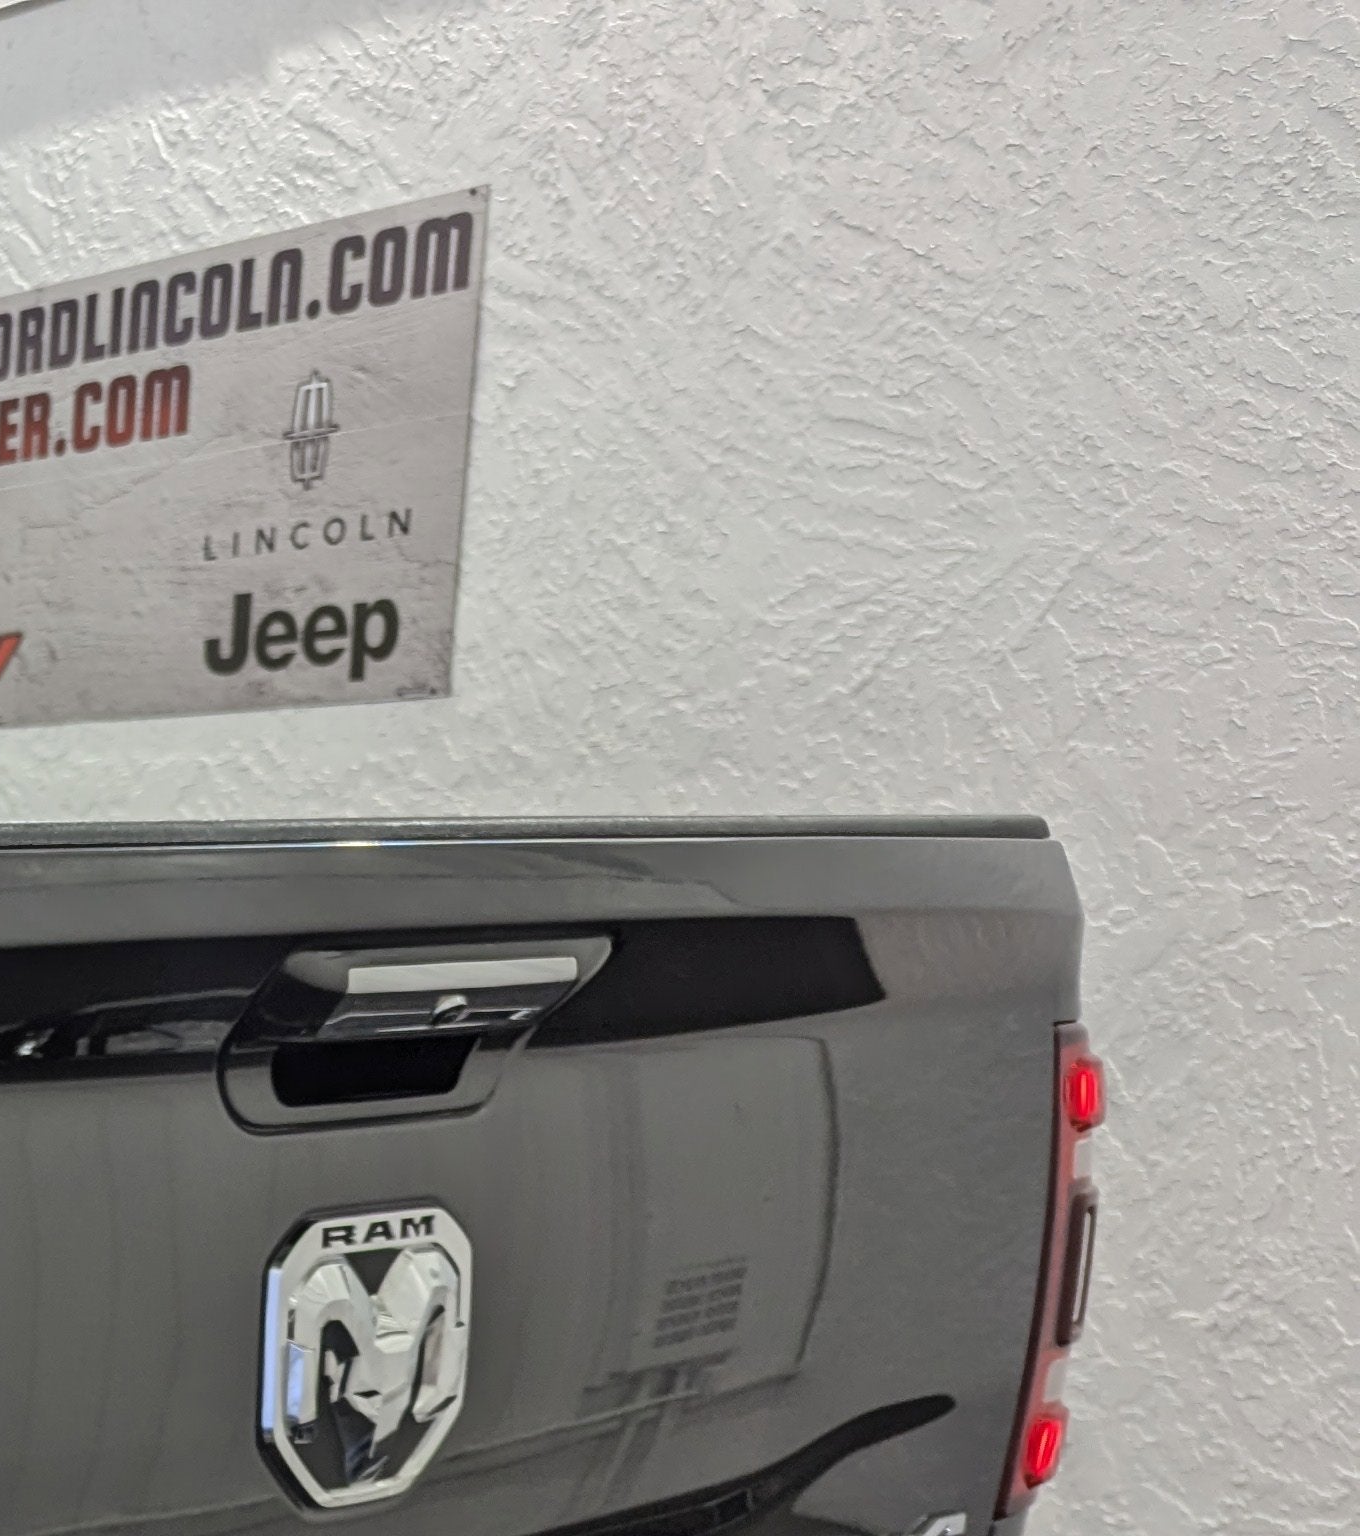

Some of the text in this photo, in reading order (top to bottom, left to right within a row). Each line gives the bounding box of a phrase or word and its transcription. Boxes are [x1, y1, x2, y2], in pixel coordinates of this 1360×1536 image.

[203, 509, 413, 561] LINCOLN
[204, 594, 400, 680] Jeep
[321, 1214, 435, 1249] RAM
